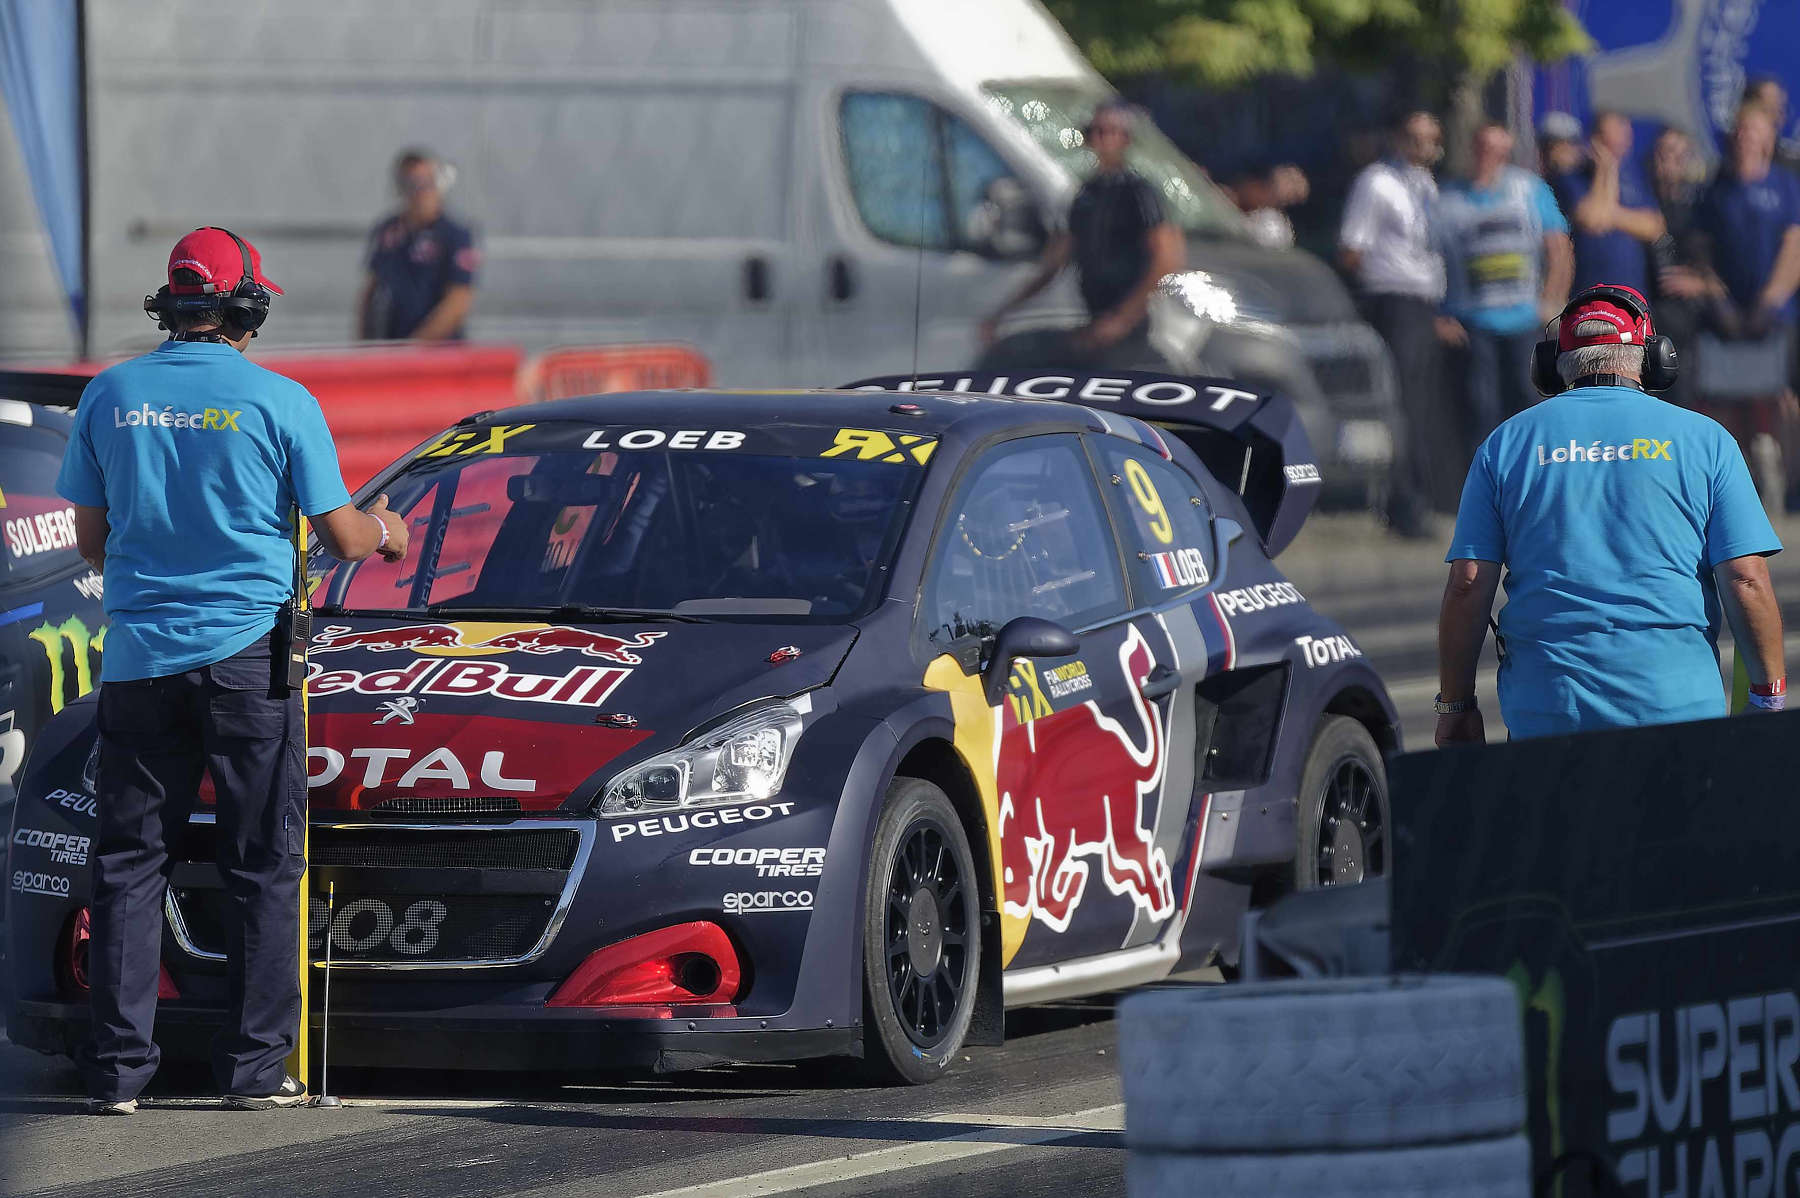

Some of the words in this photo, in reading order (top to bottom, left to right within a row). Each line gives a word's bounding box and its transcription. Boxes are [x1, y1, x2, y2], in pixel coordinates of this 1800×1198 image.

[855, 376, 1258, 411] EUGEOT
[114, 403, 243, 432] LohéacRX
[582, 430, 746, 450] LOEB
[1537, 438, 1672, 466] LohéacRX
[1123, 458, 1174, 544] 9
[1169, 548, 1210, 586] LOEB
[1217, 581, 1306, 617] PEUGEOT
[420, 660, 634, 707] Bull
[308, 747, 537, 792] OTAL
[611, 802, 795, 843] PEUGEOT
[13, 828, 91, 854] COOPER
[50, 850, 88, 866] TIRES
[688, 848, 826, 865] COOPER
[755, 863, 823, 878] TIRES
[12, 870, 70, 894] sparco
[722, 890, 813, 914] sparco
[1605, 991, 1800, 1144] SUPER
